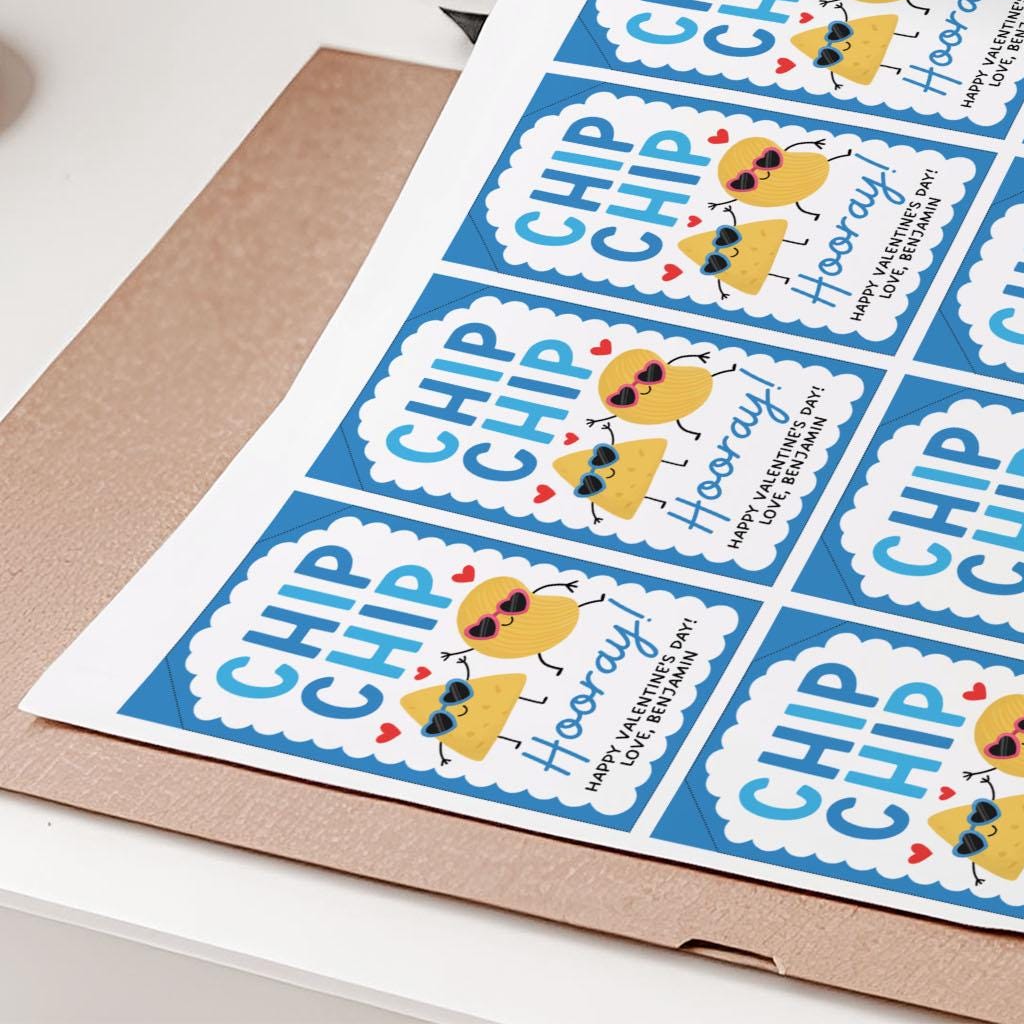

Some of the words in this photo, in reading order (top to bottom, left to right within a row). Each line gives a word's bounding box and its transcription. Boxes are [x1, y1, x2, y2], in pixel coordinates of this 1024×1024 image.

[960, 69, 989, 108] HAPPY
[988, 56, 1017, 87] LOVE,
[514, 116, 634, 247] CHIP
[590, 130, 711, 262] CHIP
[791, 153, 906, 308] Hooray!
[849, 279, 879, 322] HAPPY
[872, 201, 922, 276] VALENTINE'S
[915, 168, 939, 197] DAY!
[879, 266, 909, 299] LOVE,
[898, 196, 942, 262] BENJAMIN
[385, 322, 516, 463] CHIP
[462, 339, 592, 482] CHIP
[667, 368, 790, 534] Hooray!
[727, 504, 759, 549] HAPPY
[752, 420, 807, 500] VALENTINE'S
[799, 385, 825, 416] DAY!
[758, 490, 791, 525] LOVE,
[780, 416, 828, 485] BENJAMIN
[872, 426, 1002, 577] CHIP
[215, 545, 371, 699] CHIP
[300, 564, 453, 720] CHIP
[522, 598, 659, 776] Hooray!
[584, 744, 622, 792] HAPPY
[615, 654, 676, 740] VALENTINE'S
[669, 617, 698, 650] DAY!
[619, 729, 656, 767] LOVE,
[646, 650, 699, 724] BENJAMIN
[738, 662, 879, 821] CHIP
[826, 682, 966, 840] CHIP
